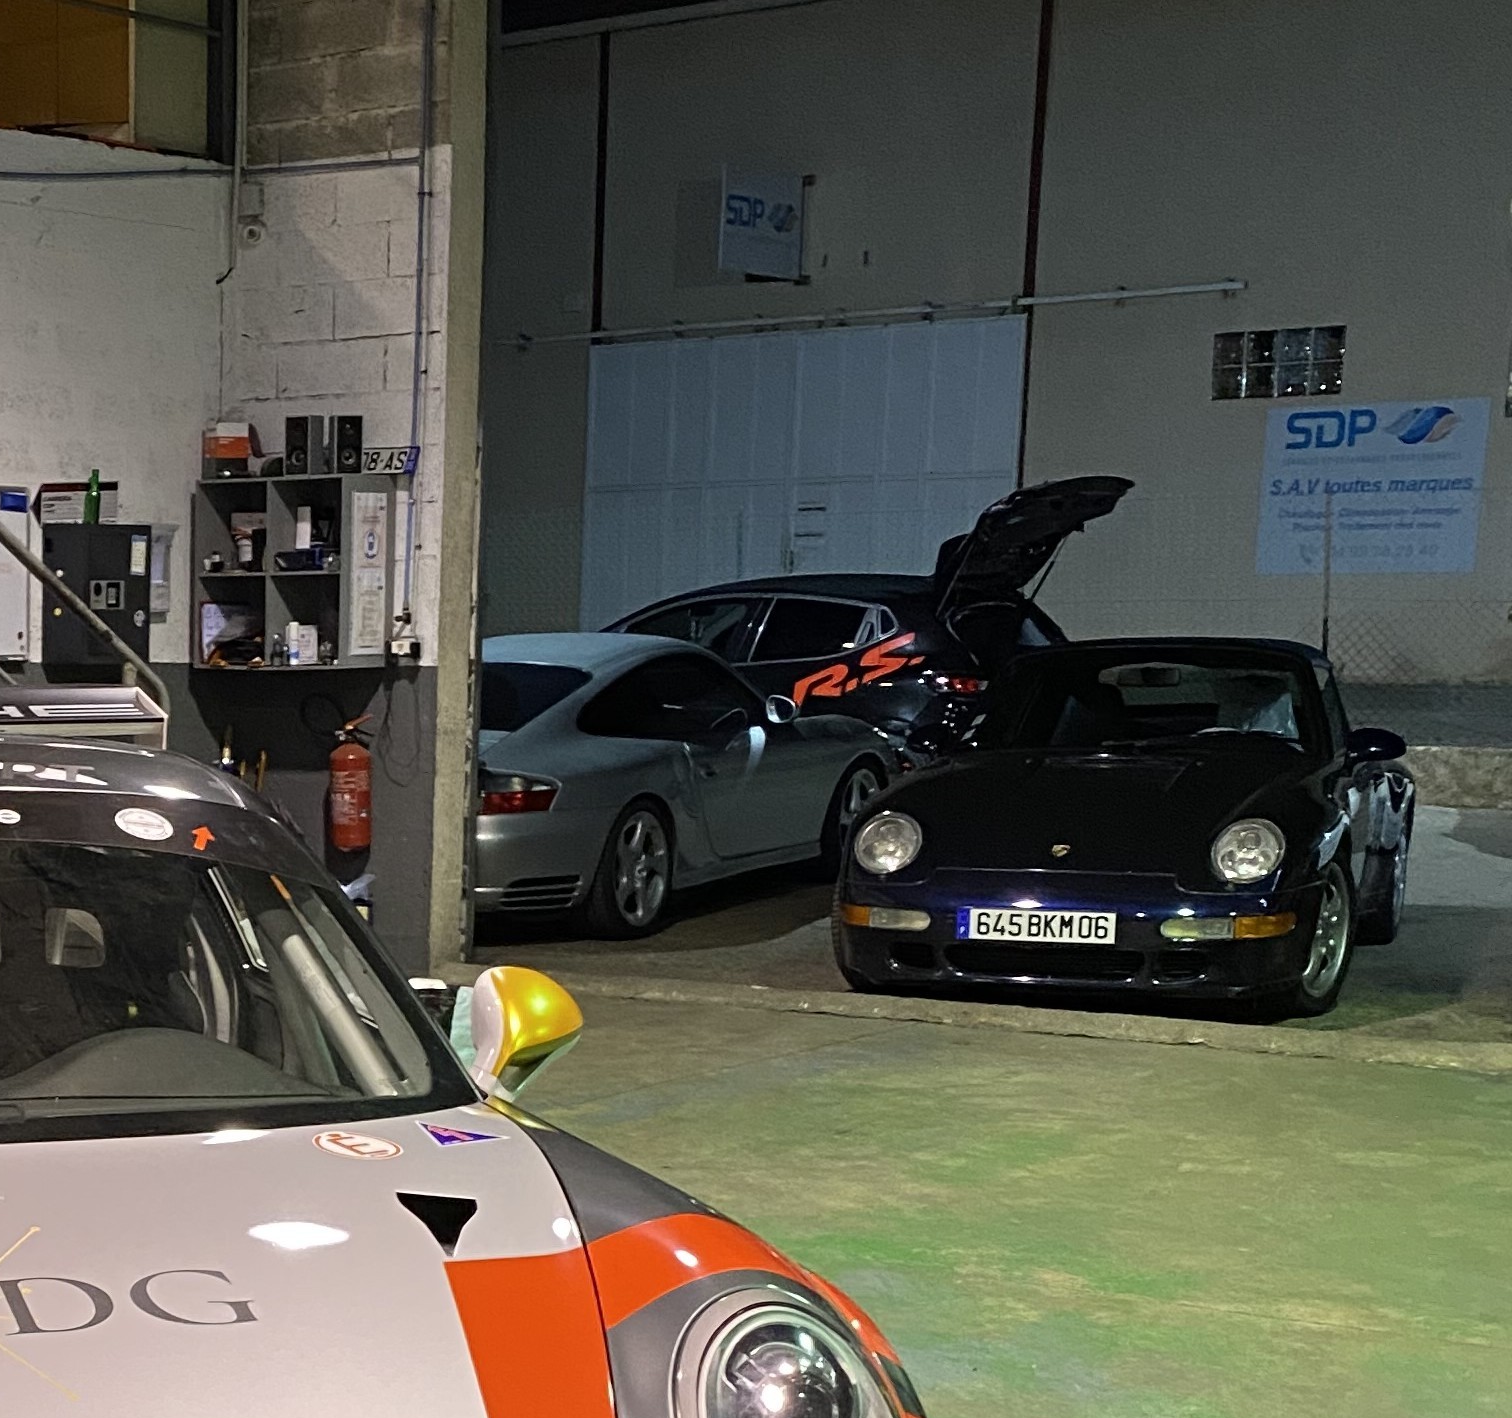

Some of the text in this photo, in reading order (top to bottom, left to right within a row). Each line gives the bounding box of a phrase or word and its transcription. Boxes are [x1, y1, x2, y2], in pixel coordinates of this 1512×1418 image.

[726, 194, 765, 227] SDP
[1285, 408, 1377, 450] SDP
[1323, 478, 1382, 496] toutes
[1387, 477, 1475, 494] marques
